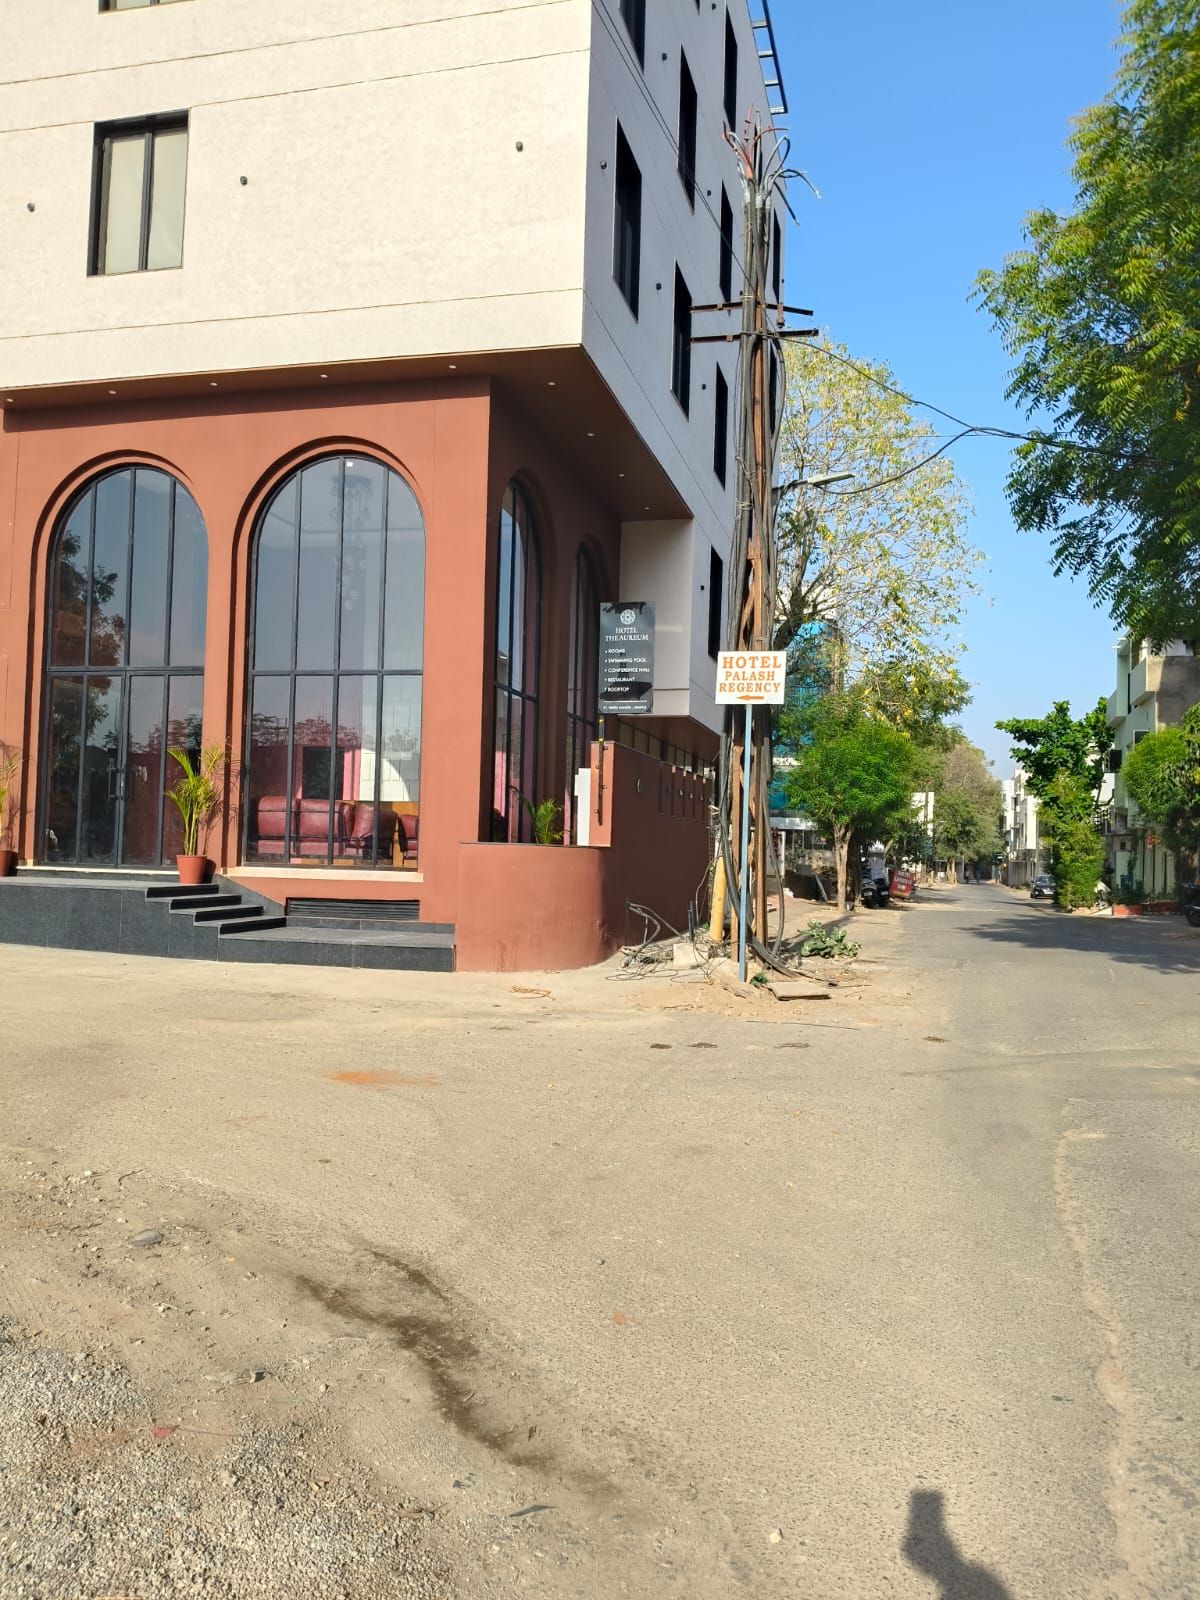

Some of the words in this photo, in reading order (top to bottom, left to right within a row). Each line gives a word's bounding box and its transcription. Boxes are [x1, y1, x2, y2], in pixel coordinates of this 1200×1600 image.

[722, 656, 782, 668] HOTEL
[725, 671, 775, 681] PALASH
[719, 682, 781, 692] REGENCY
